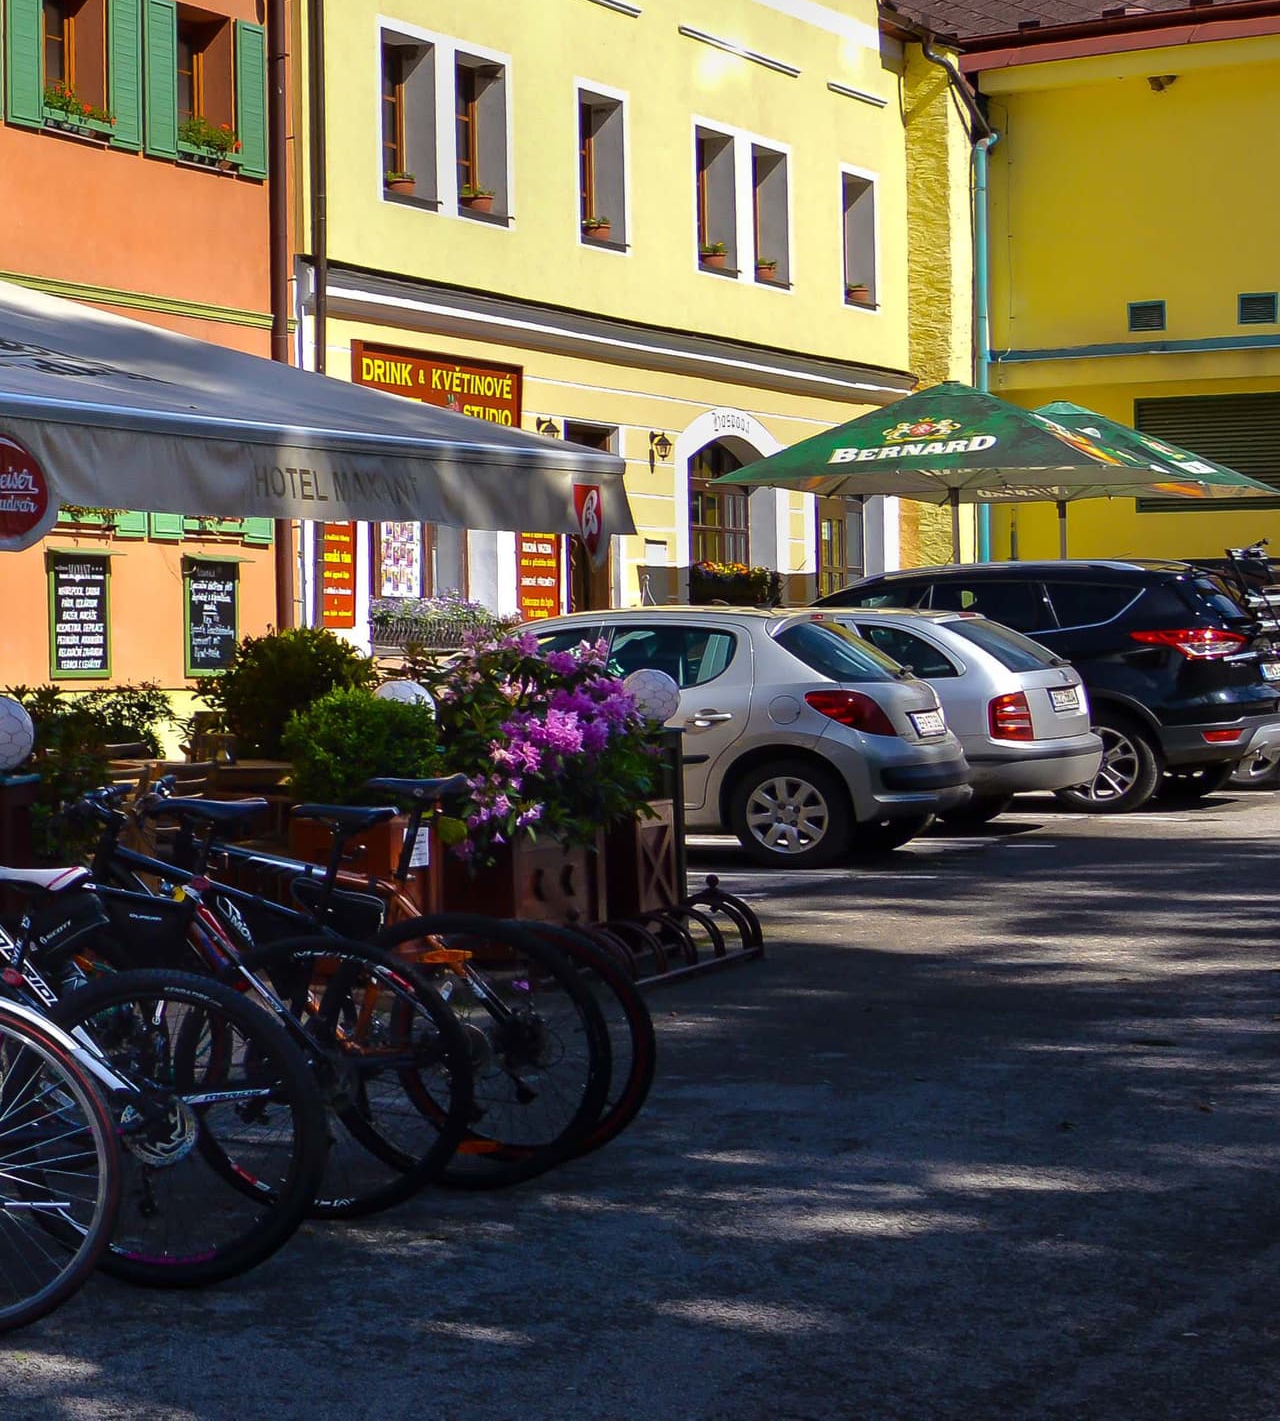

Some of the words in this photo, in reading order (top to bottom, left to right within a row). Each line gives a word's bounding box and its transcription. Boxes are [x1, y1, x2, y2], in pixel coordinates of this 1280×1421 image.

[361, 356, 413, 387] DRINK
[418, 369, 425, 384] &
[431, 366, 513, 399] KVĚTINOVÉ
[827, 433, 998, 464] BERNARD
[254, 466, 328, 502] HOTEL
[46, 919, 71, 940] SCOTT
